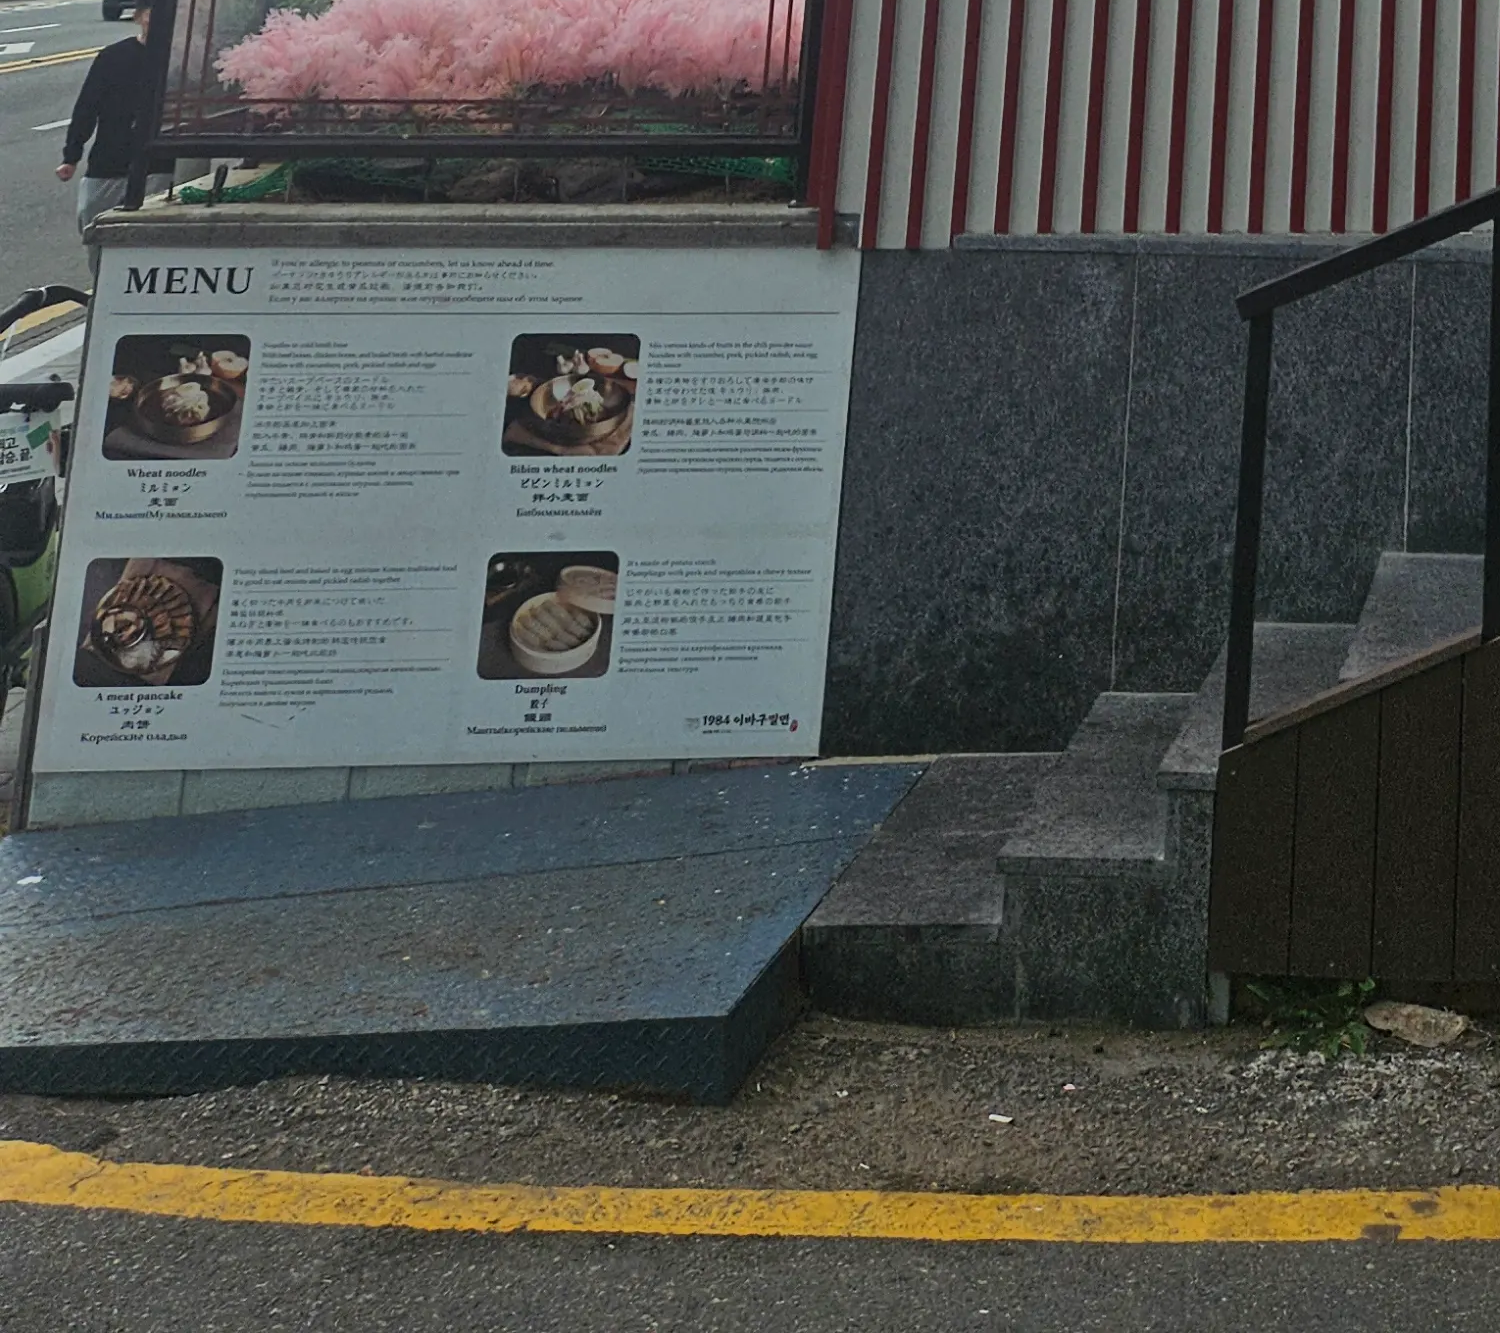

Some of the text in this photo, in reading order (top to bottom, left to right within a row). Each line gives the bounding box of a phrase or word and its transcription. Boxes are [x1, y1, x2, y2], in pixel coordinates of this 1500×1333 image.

[124, 266, 254, 296] MENU
[127, 467, 208, 478] Wheat noodles
[510, 463, 618, 475] Bibim wheat noodles
[515, 683, 568, 696] Dumpling
[95, 690, 183, 703] A meat pancake
[703, 714, 731, 726] 1984
[733, 712, 790, 727] 이바구밀면
